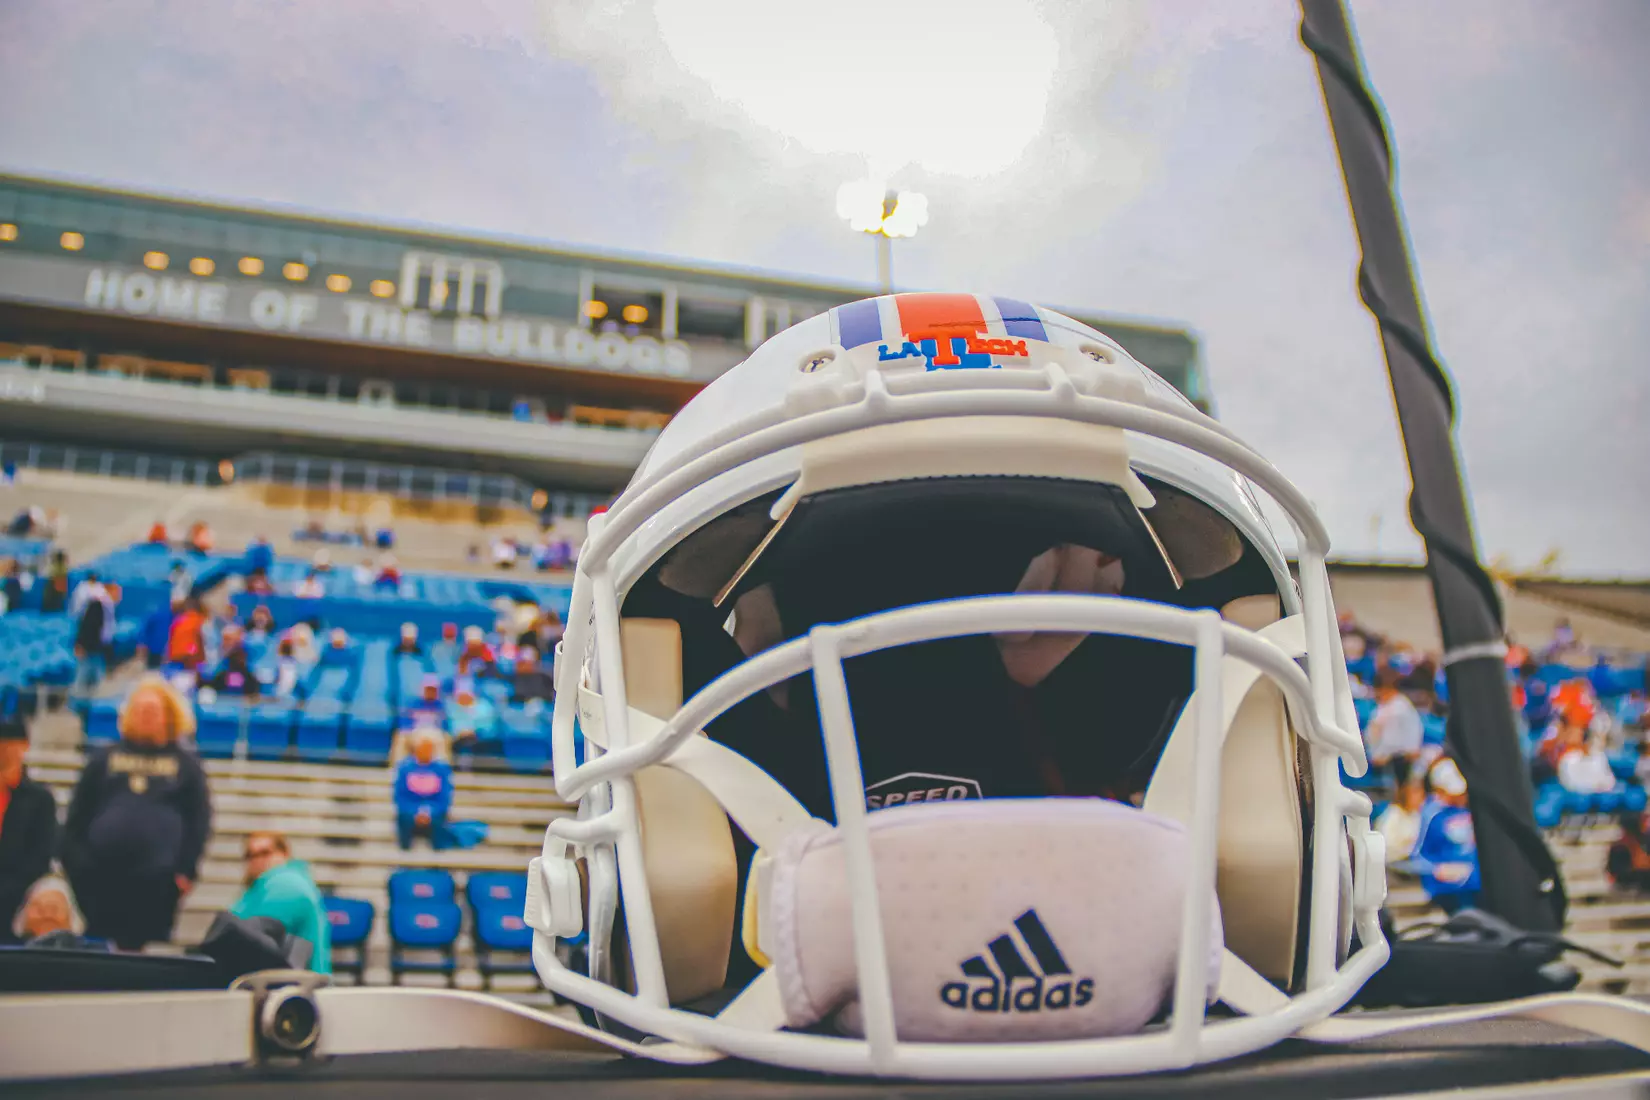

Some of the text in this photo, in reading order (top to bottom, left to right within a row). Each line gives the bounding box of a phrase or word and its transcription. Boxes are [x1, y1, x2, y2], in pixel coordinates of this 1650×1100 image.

[84, 268, 691, 377] HOME OF THE BULLDOGS
[866, 785, 969, 808] SPEED
[940, 973, 1095, 1012] adidas
